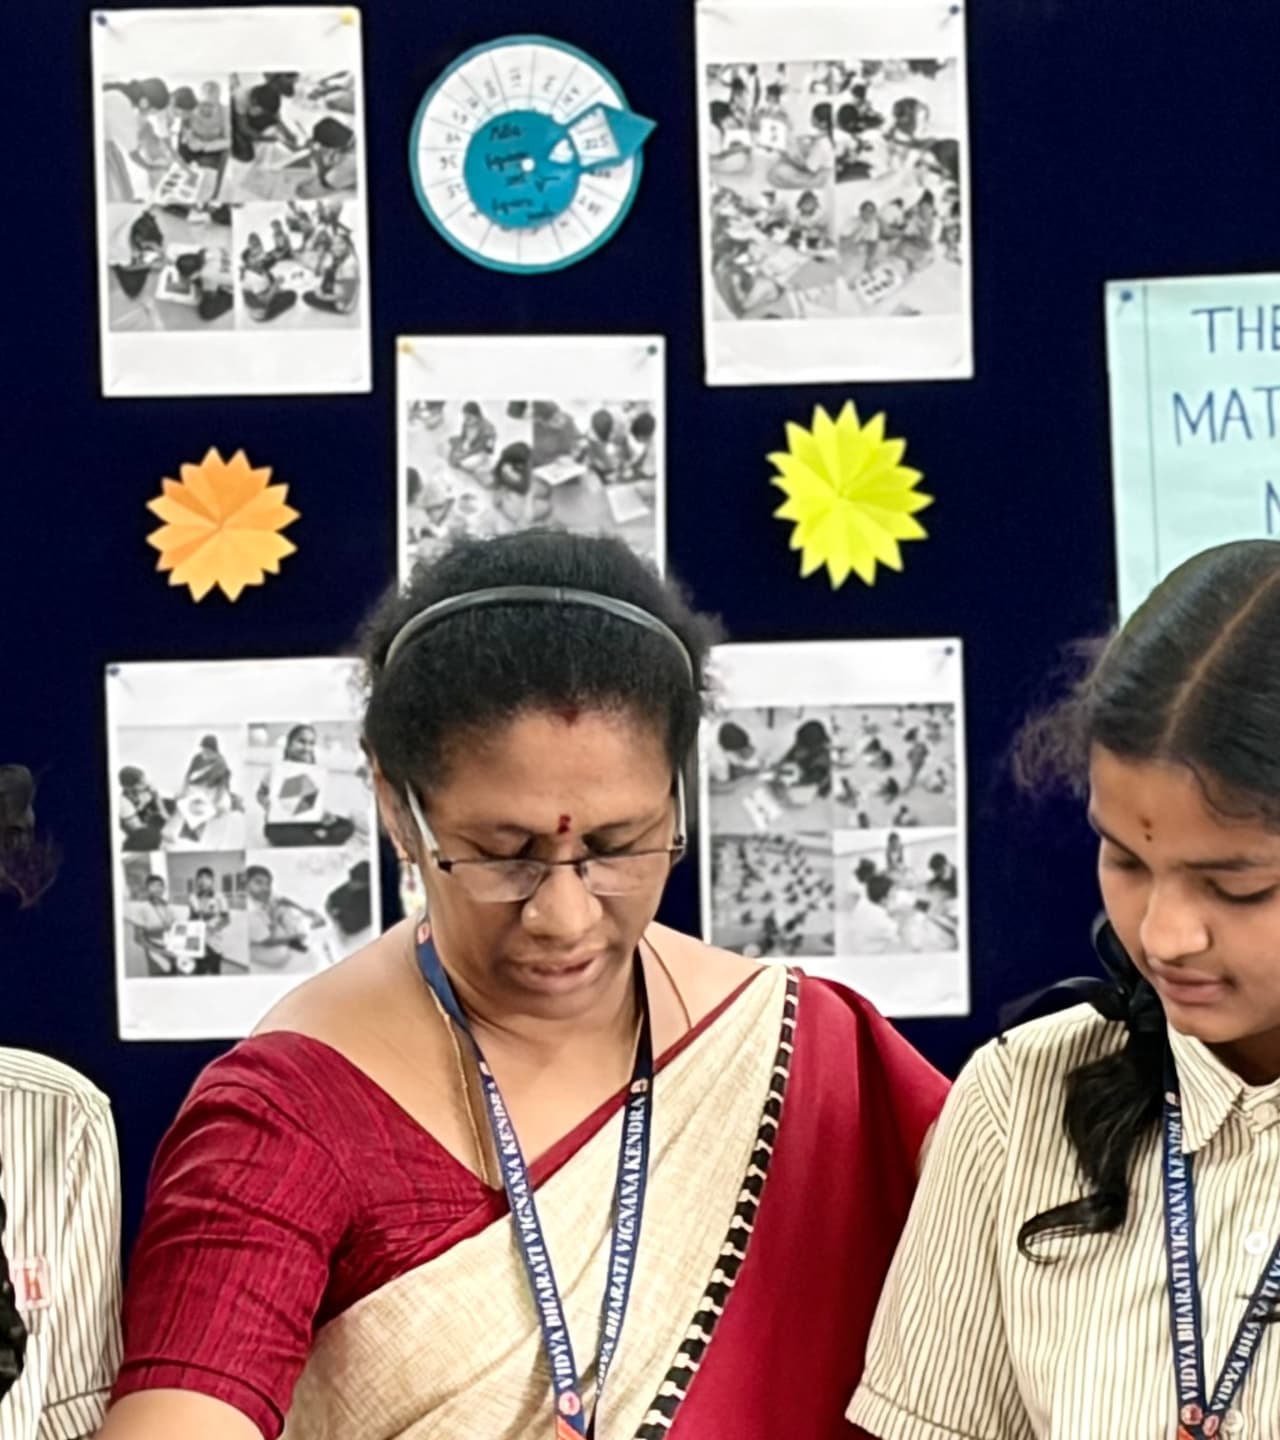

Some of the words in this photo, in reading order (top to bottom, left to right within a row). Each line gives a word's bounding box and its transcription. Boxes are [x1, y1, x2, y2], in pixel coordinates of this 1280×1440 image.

[622, 1097, 646, 1173] KENDRA
[505, 1157, 539, 1244] VIGNANA
[614, 1174, 641, 1252] VIGNANA
[1168, 1181, 1190, 1261] VIGNANA
[526, 1245, 562, 1328] BHARATI
[604, 1255, 631, 1338] BHARATI
[1172, 1262, 1194, 1341] BHARATI
[548, 1333, 574, 1389] VIDYA
[1179, 1345, 1199, 1401] VIDYA
[1211, 1361, 1246, 1412] VIDYA
